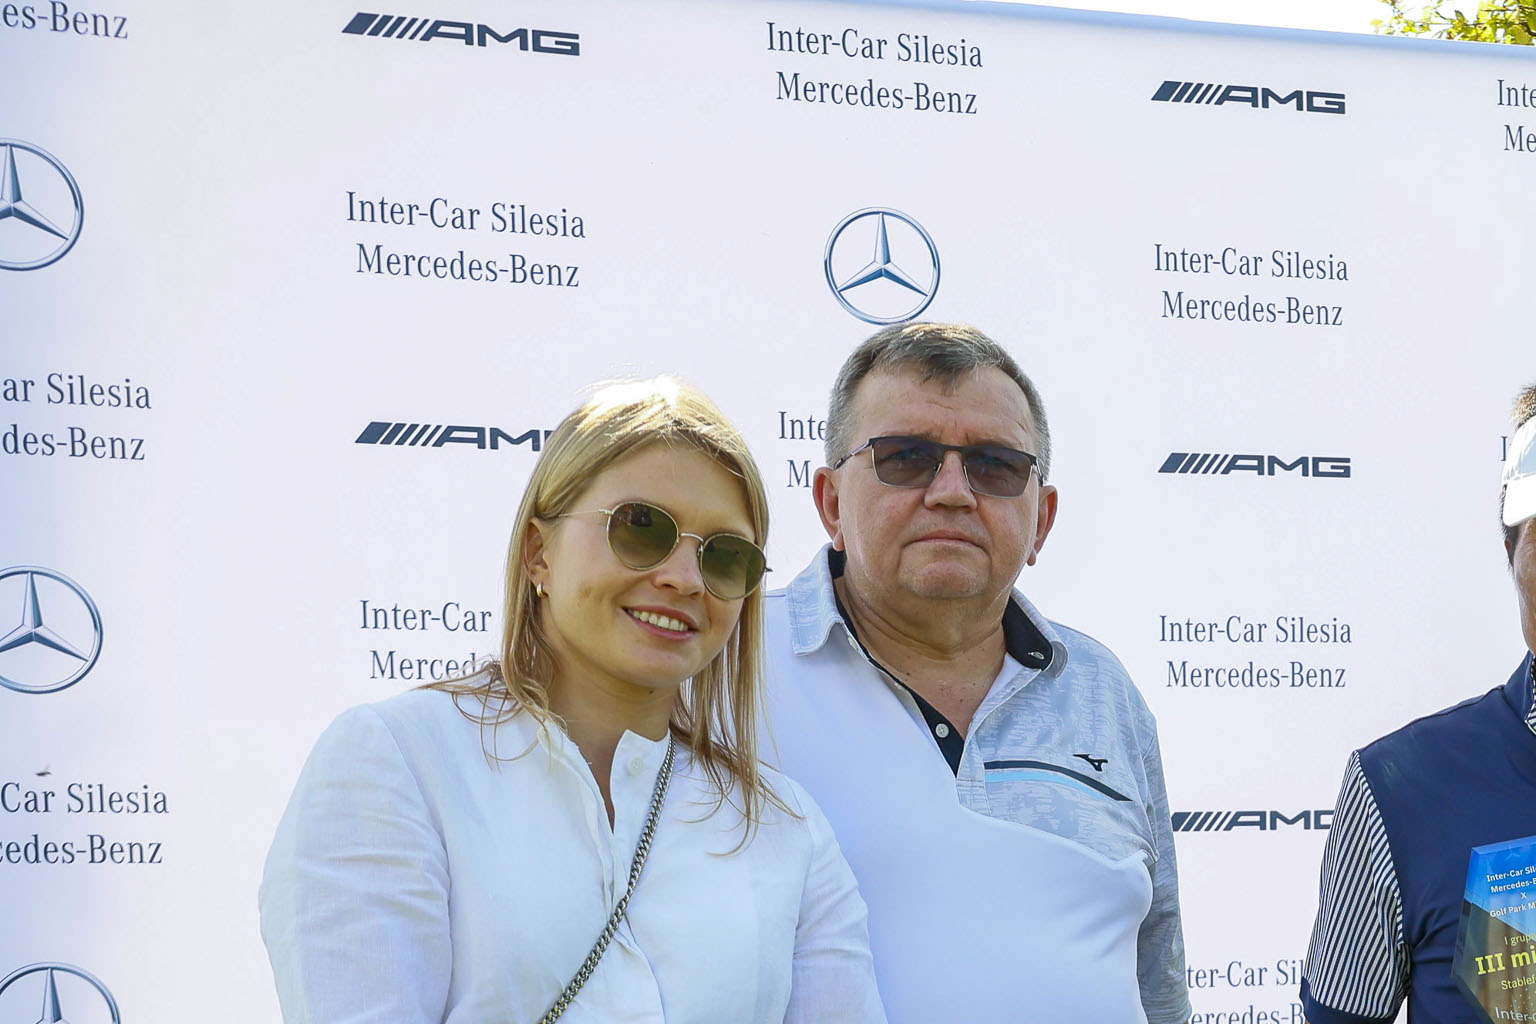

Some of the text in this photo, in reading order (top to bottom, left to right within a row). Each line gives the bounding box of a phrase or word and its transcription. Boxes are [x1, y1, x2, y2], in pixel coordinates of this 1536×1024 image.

[429, 19, 580, 56] AMG
[765, 21, 984, 68] Inter-Car Silesia
[775, 70, 978, 115] Mercedes-Benz
[1217, 86, 1346, 115] AMG
[345, 190, 587, 239] Inter-Car Silesia
[355, 242, 580, 288] Mercedes-Benz
[1153, 243, 1349, 282] Inter-Car Silesia
[1161, 290, 1344, 327] Mercedes-Benz
[46, 372, 153, 410] Silesia
[441, 425, 557, 452] AM
[1222, 454, 1351, 478] AMG
[359, 599, 493, 633] Inter-Car
[1159, 614, 1353, 644] Inter-Car Silesia
[1165, 660, 1347, 689] Mercedes-Benz
[66, 782, 170, 815] Silesia
[1487, 869, 1523, 882] Inter-Car
[1490, 906, 1507, 917] Golf
[1508, 903, 1527, 913] Park
[1475, 953, 1506, 975] III
